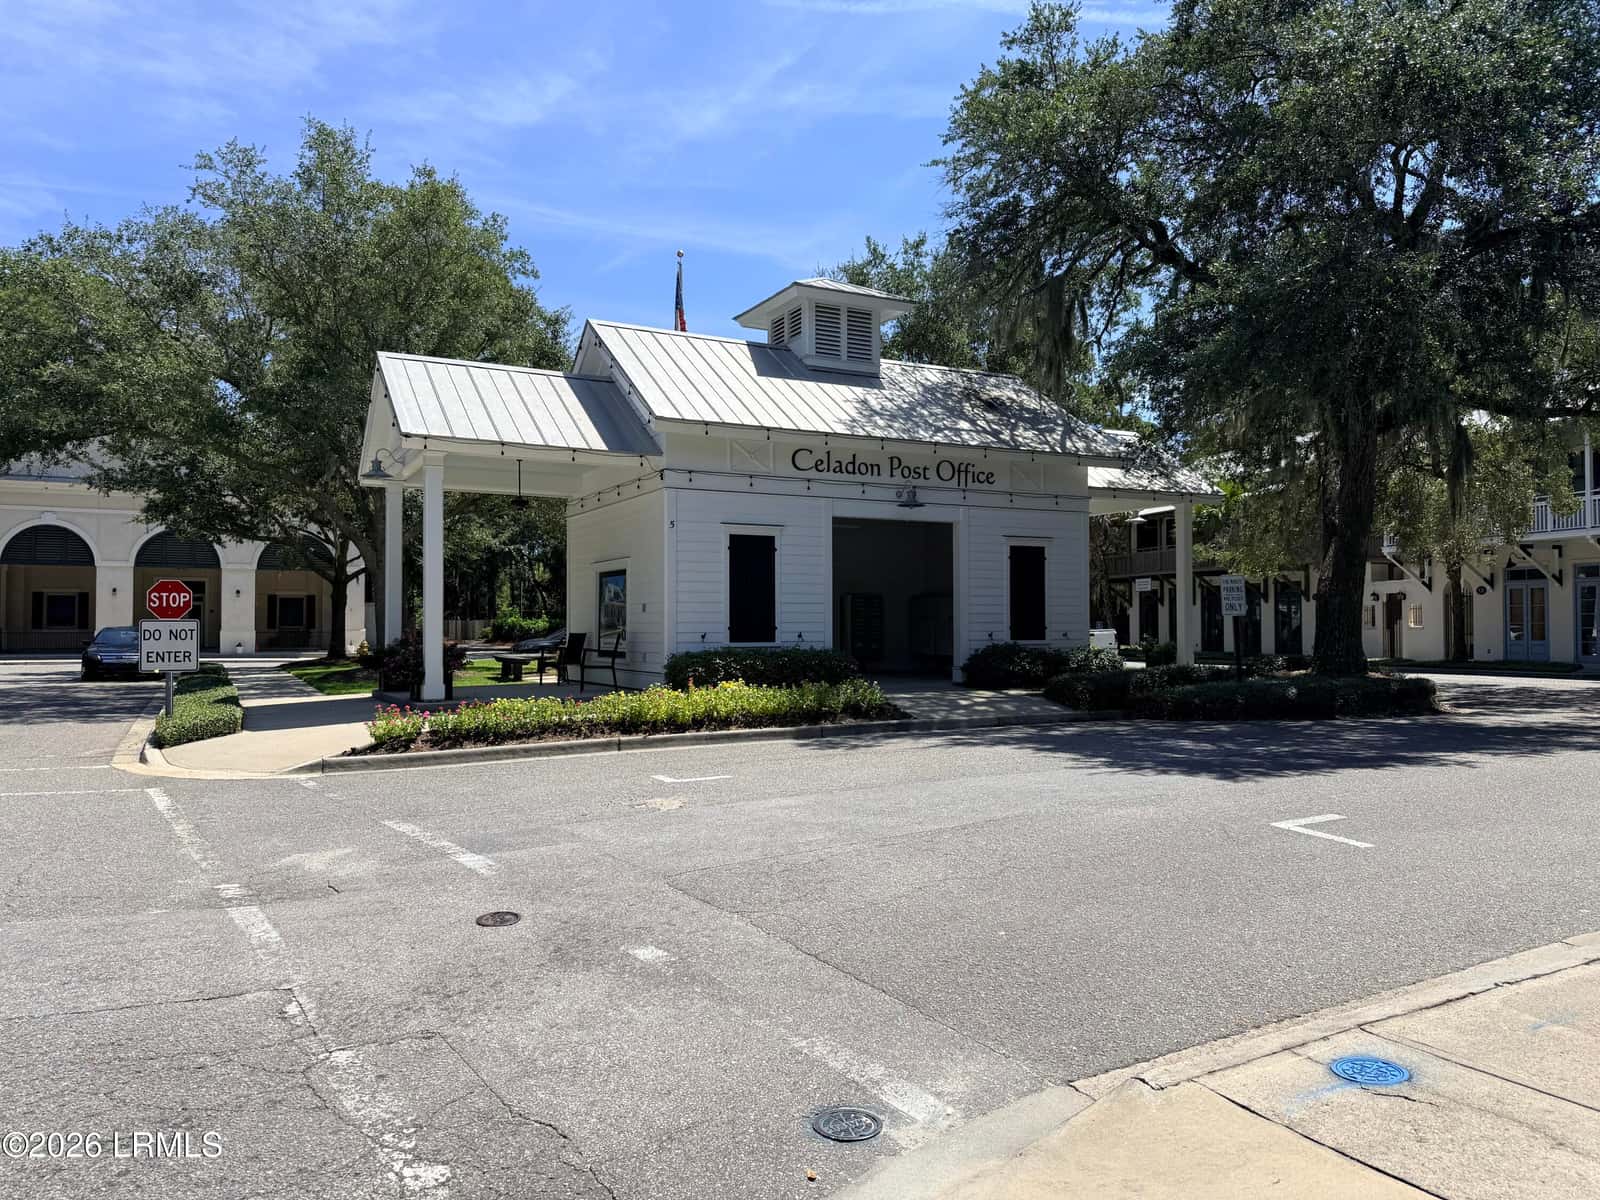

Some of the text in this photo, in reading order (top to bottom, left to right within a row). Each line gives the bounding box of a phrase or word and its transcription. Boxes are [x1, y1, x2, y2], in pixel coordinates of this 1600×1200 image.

[791, 448, 996, 488] Celadon Post Office
[668, 519, 675, 529] 5
[150, 592, 190, 608] STOP
[1224, 602, 1242, 611] ONLY
[143, 629, 196, 641] DO NOT
[146, 650, 192, 663] ENTER
